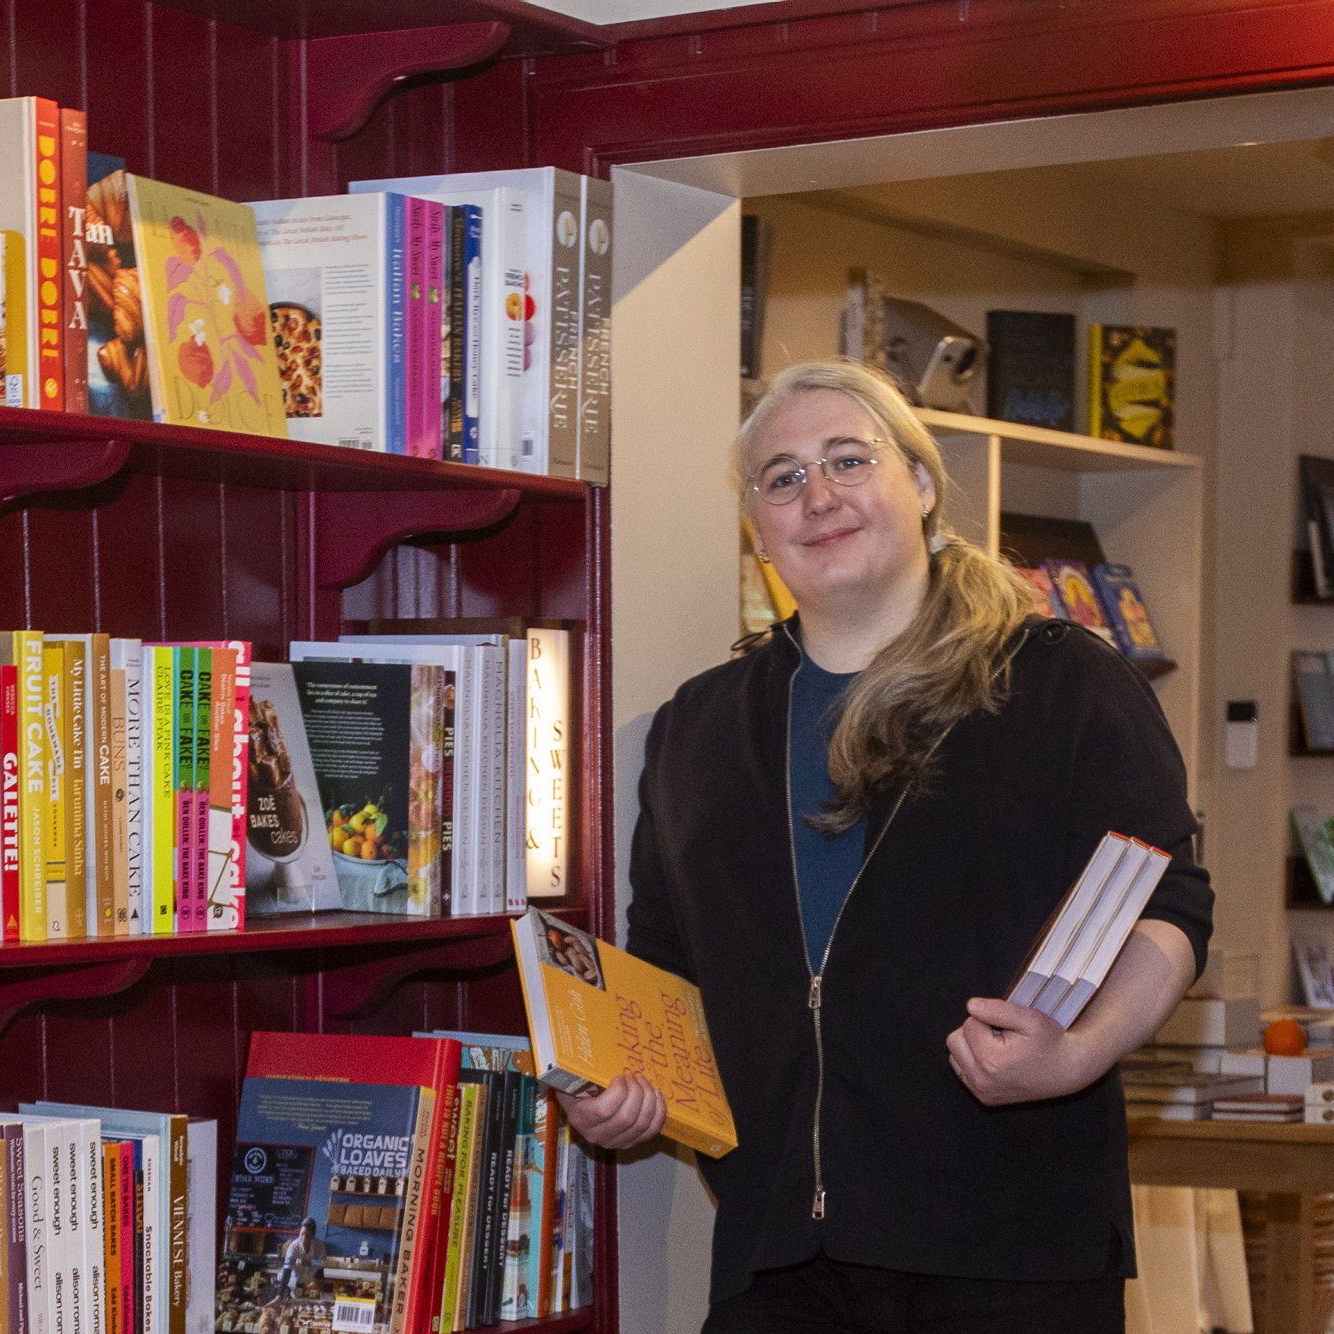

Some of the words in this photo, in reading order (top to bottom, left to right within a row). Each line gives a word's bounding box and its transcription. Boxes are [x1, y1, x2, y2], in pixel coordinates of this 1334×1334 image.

[69, 206, 88, 330] TAVA
[26, 640, 43, 716] FRUIT
[128, 678, 140, 749] MORE
[27, 722, 43, 793] CAKE
[113, 716, 125, 772] BUNS
[3, 752, 18, 872] GALETTE!
[128, 754, 140, 824] THAN
[549, 719, 565, 888] SWEETS
[250, 814, 280, 829] BAKES
[271, 828, 298, 845] cakes
[129, 832, 140, 898] CAKE
[660, 992, 700, 1114] Meaning
[52, 1146, 60, 1188] sweet
[340, 1150, 407, 1166] LOAVES
[342, 1133, 409, 1151] ORGANIC
[30, 1176, 44, 1224] Good
[405, 1148, 425, 1243] MORNING
[488, 1152, 497, 1192] READY
[52, 1188, 62, 1236] enough
[172, 1195, 184, 1266] VIENNESE
[486, 1195, 495, 1212] for
[32, 1228, 43, 1241] &
[144, 1226, 153, 1293] Snackable
[482, 1215, 492, 1271] DESSERT
[33, 1244, 45, 1292] Sweet
[55, 1272, 65, 1310] alison
[172, 1271, 182, 1307] Bakery
[395, 1249, 413, 1314] BAKER
[144, 1295, 153, 1333] Bakes
